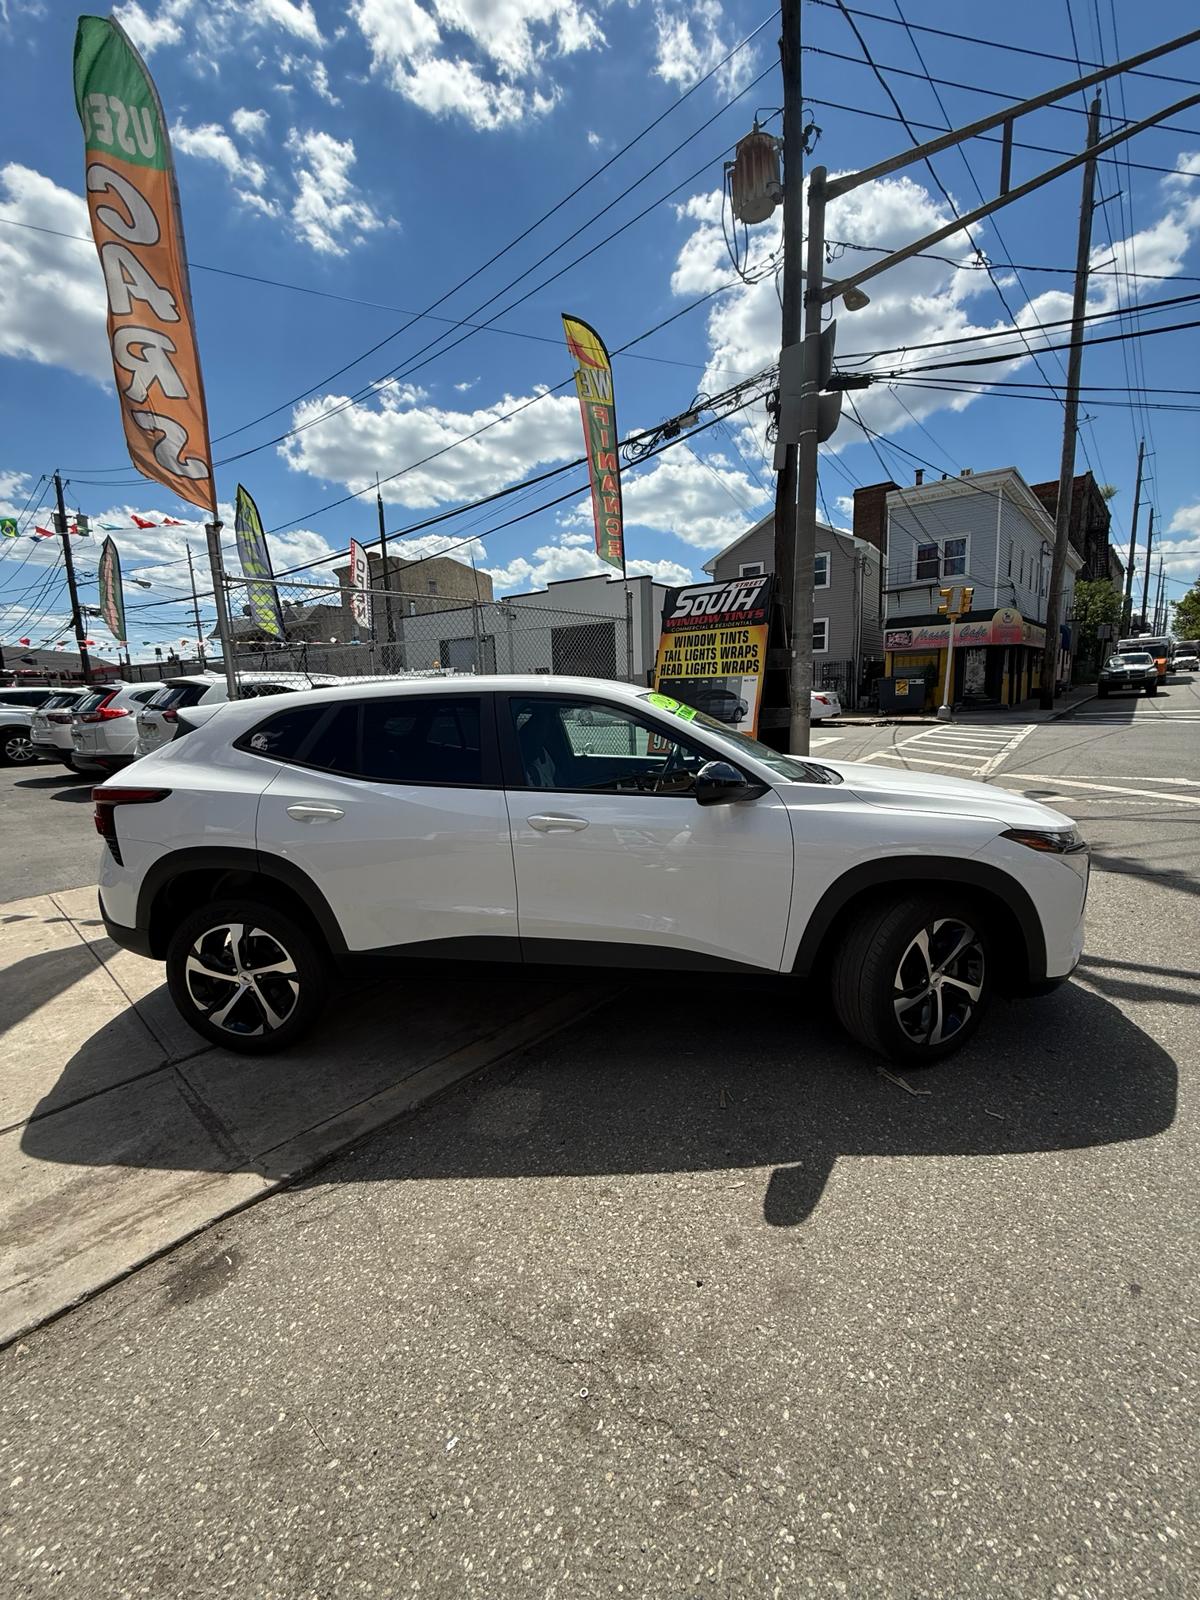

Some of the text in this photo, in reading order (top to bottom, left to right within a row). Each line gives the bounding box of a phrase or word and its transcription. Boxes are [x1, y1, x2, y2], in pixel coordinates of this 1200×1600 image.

[734, 579, 763, 589] STREET
[670, 579, 764, 618] SOUTH
[666, 608, 765, 627] WINDOW TINTS
[671, 624, 709, 632] COMMERCIAL
[714, 620, 752, 628] RESIDENTIAL
[674, 630, 749, 649] WINDOW TINTS
[664, 644, 758, 663] TAIL LIGHTS WRAPS
[660, 659, 760, 676] HEAD LIGHTS WRAPS
